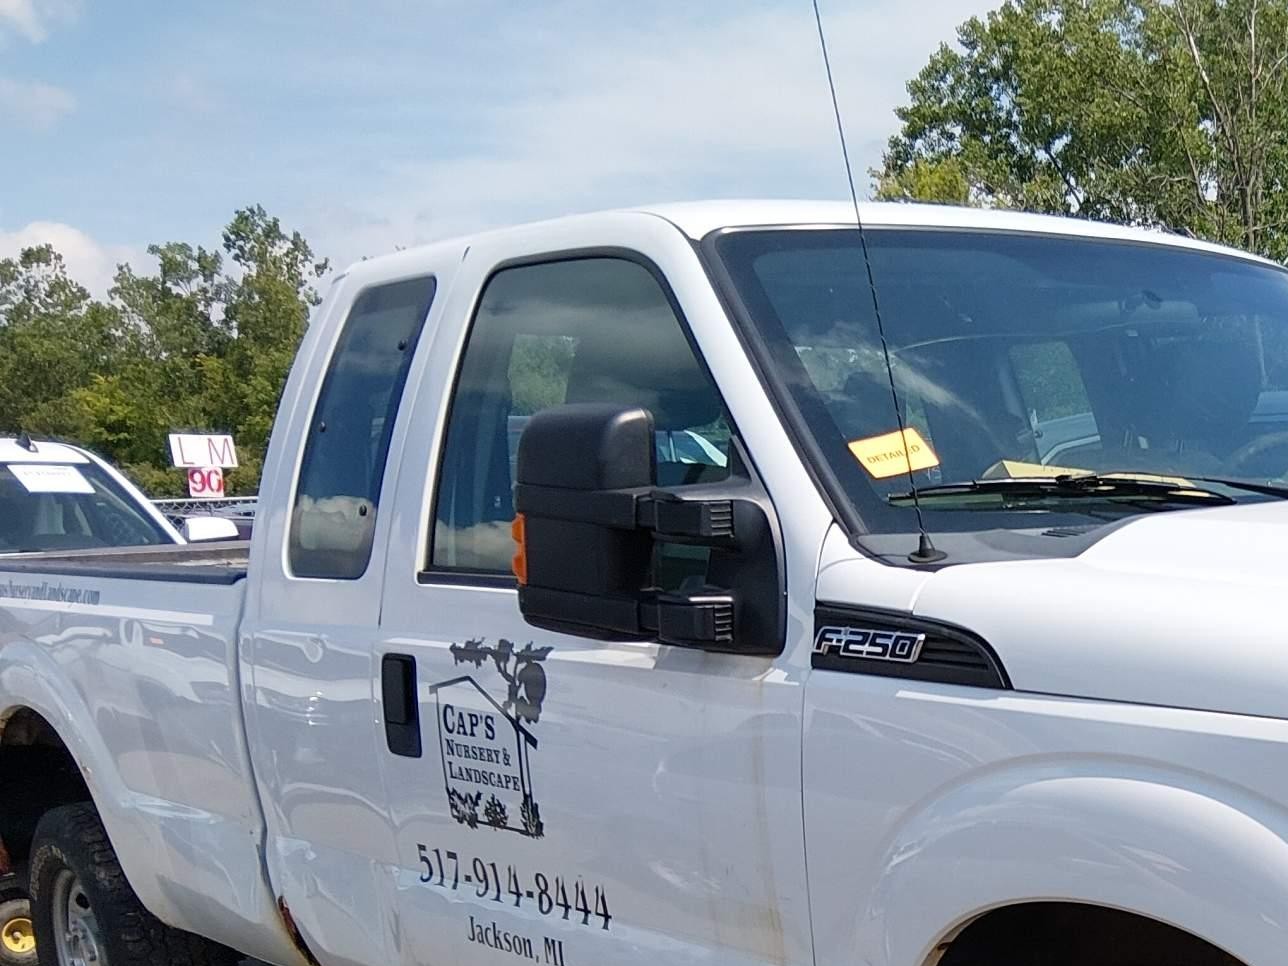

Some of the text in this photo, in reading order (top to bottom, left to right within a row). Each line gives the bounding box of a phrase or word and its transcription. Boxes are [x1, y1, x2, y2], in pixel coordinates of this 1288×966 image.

[177, 436, 234, 465] L M
[866, 444, 920, 464] DETAILD
[189, 469, 223, 493] 90
[502, 747, 512, 767] &
[417, 843, 612, 931] 517-914-8444
[467, 916, 540, 964] Jackson,
